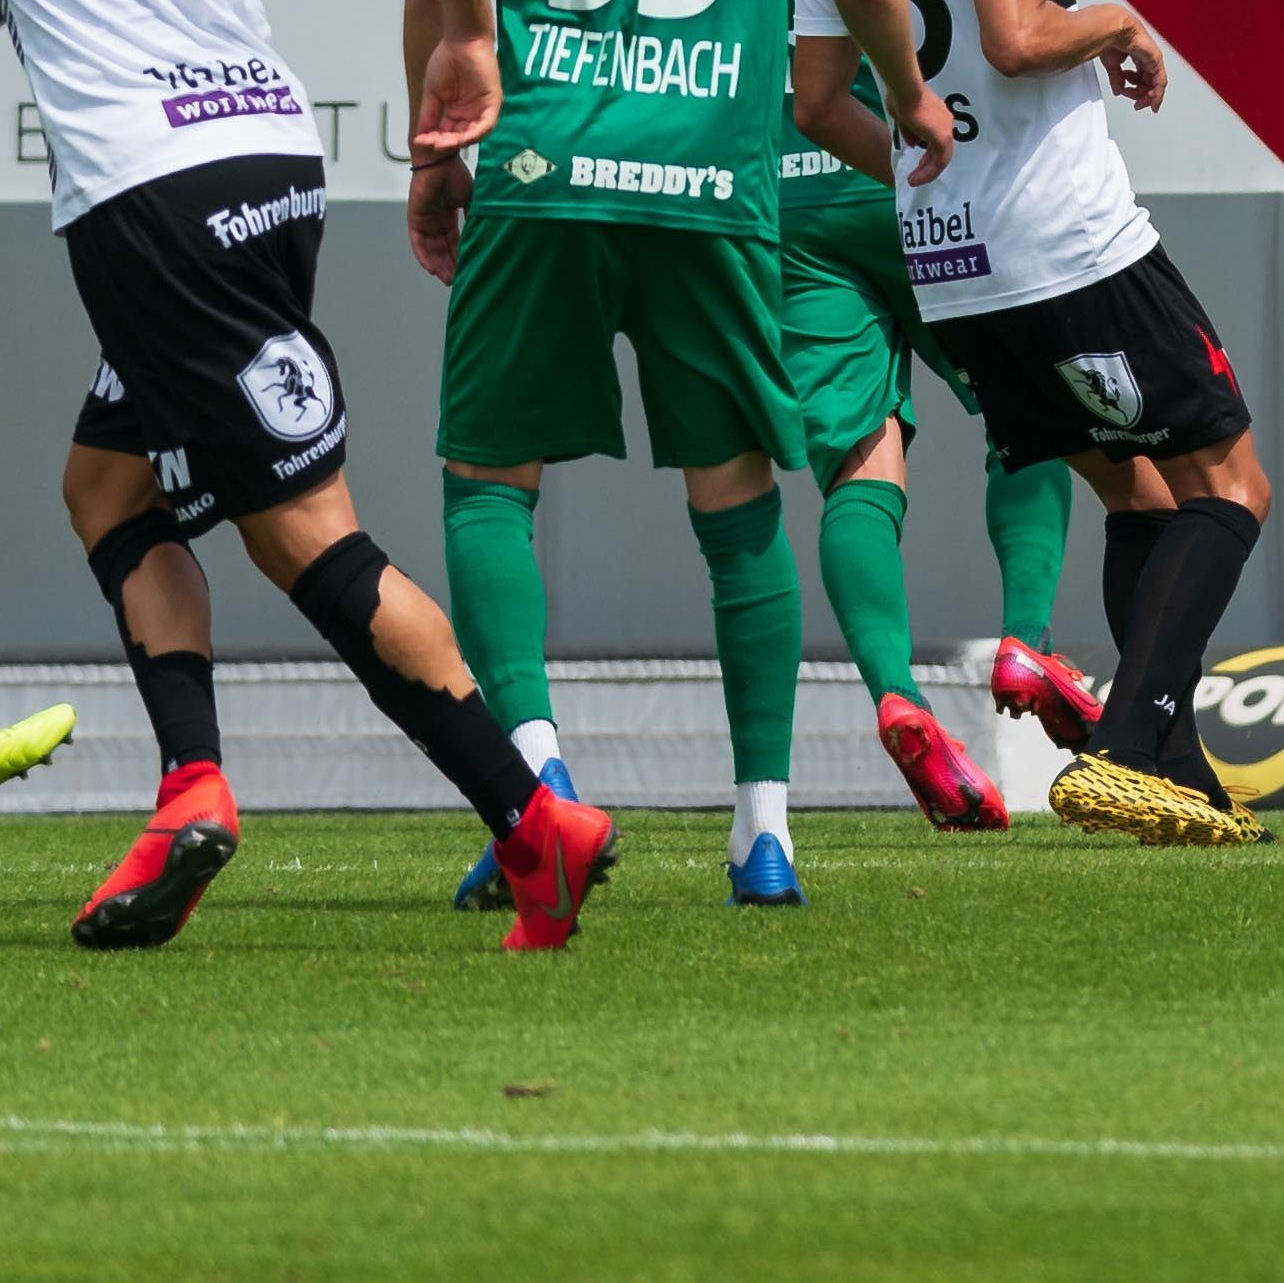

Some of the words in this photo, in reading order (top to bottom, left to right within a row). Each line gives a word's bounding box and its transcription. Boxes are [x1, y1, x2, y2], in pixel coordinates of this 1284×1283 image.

[523, 23, 742, 98] TIEFENBACH
[569, 156, 733, 200] BREDDY'S
[777, 150, 854, 178] EDD
